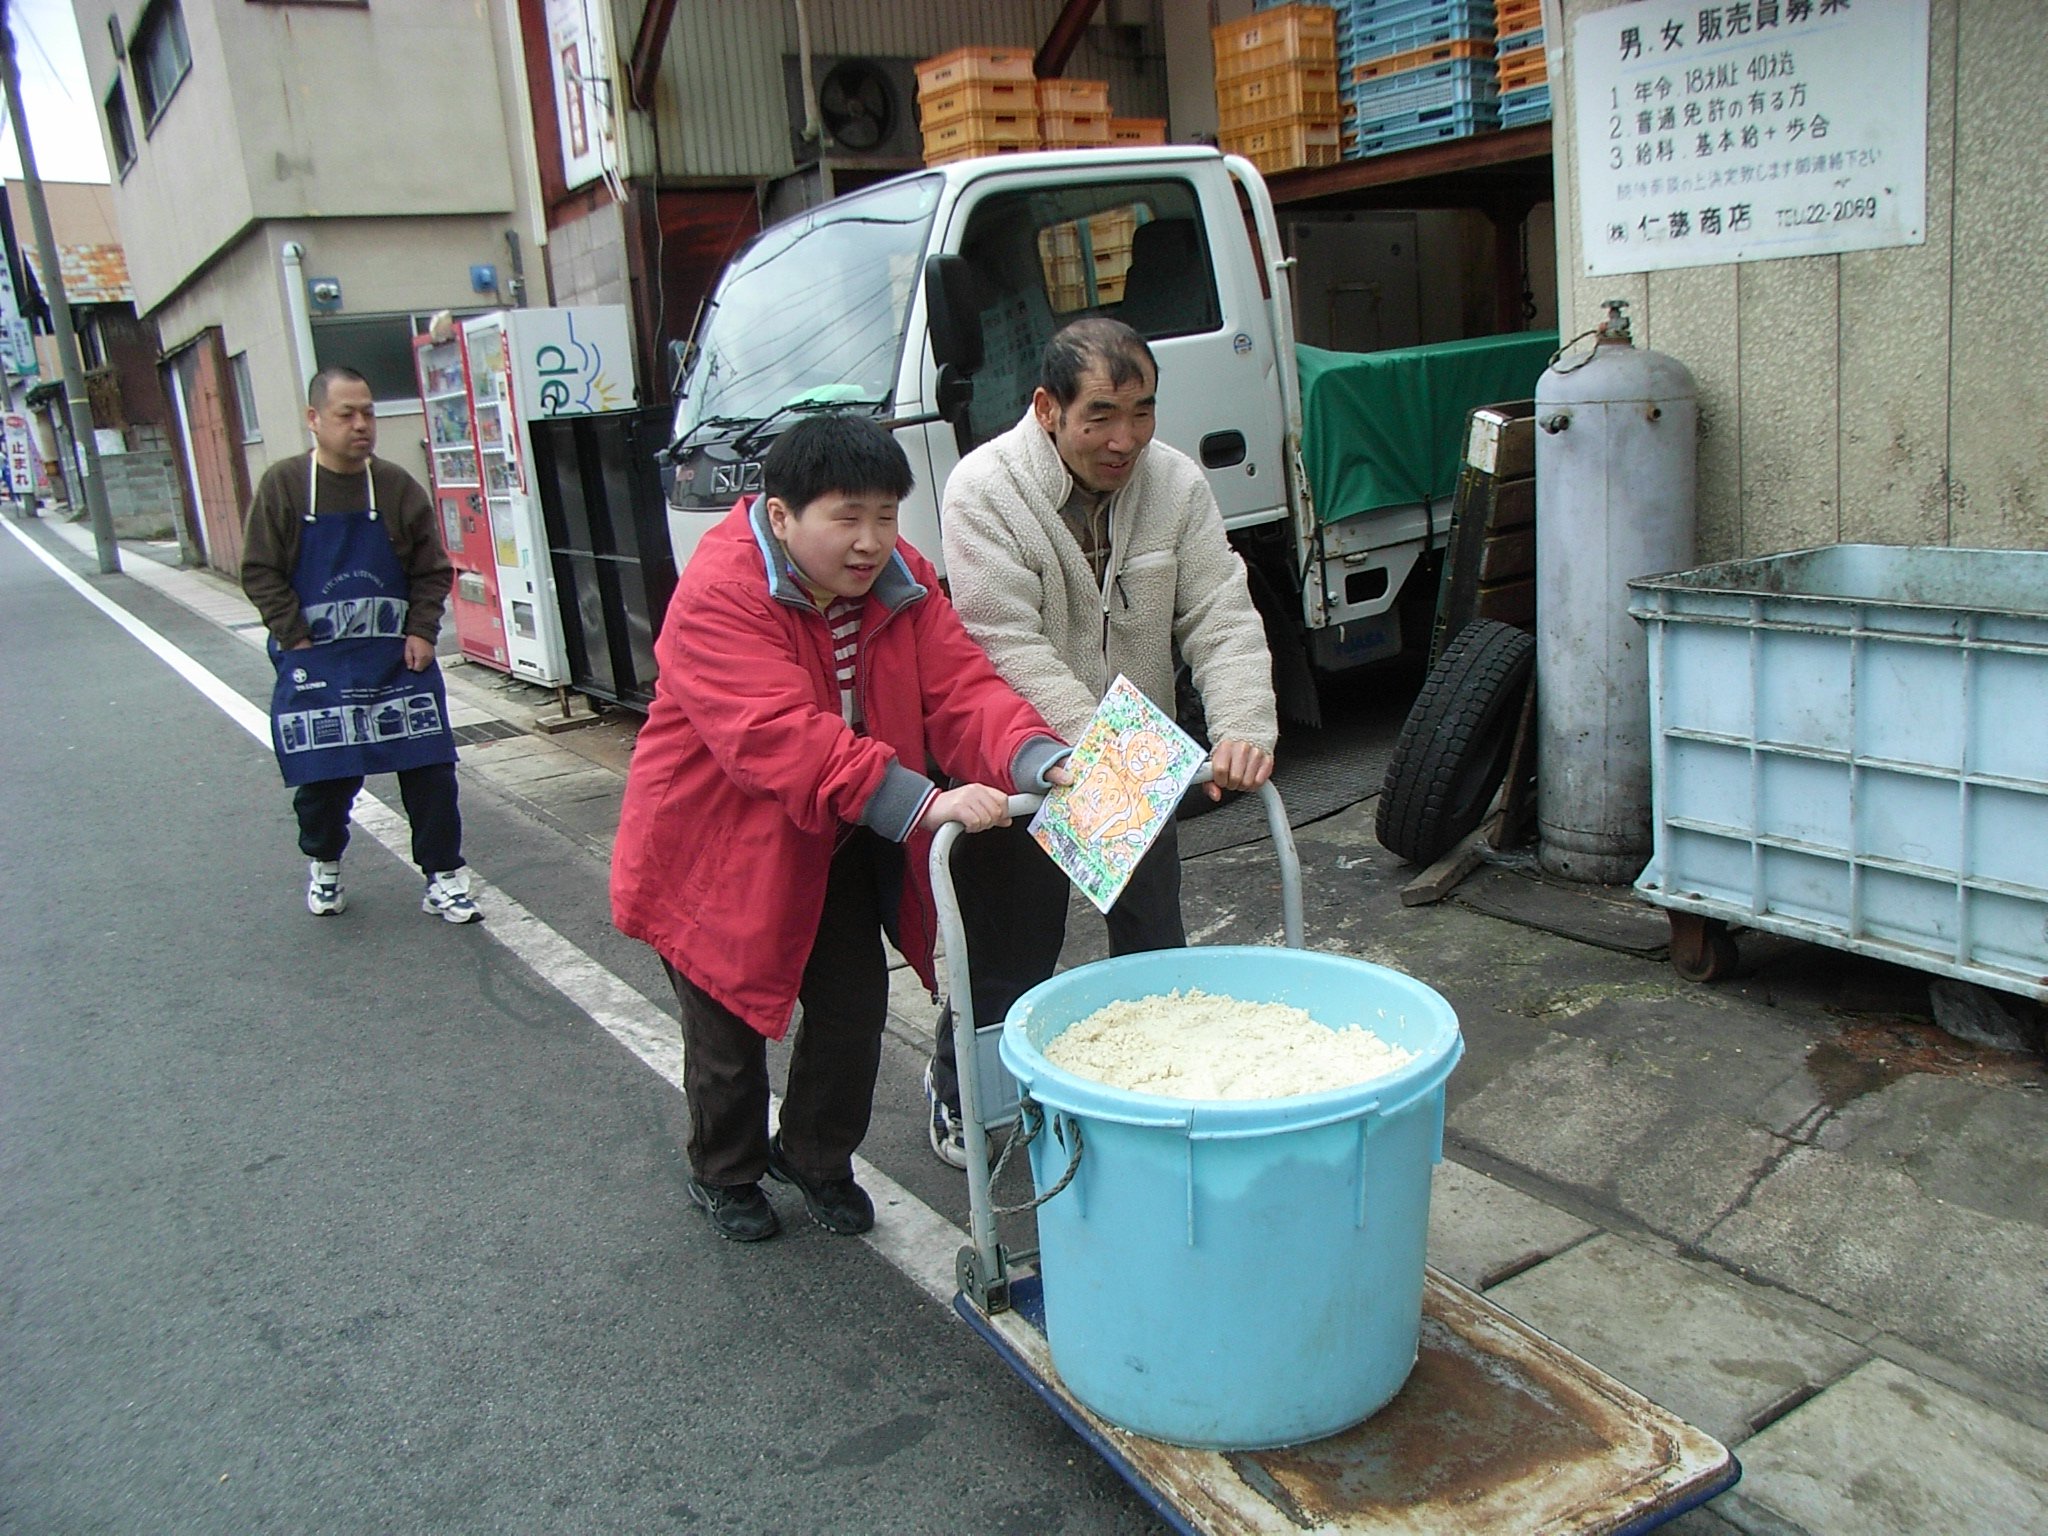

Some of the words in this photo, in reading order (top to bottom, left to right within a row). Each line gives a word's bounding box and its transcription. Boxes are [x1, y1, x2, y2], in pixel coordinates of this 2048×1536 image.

[12, 440, 30, 487] 止まれ
[711, 461, 766, 494] ISUZ
